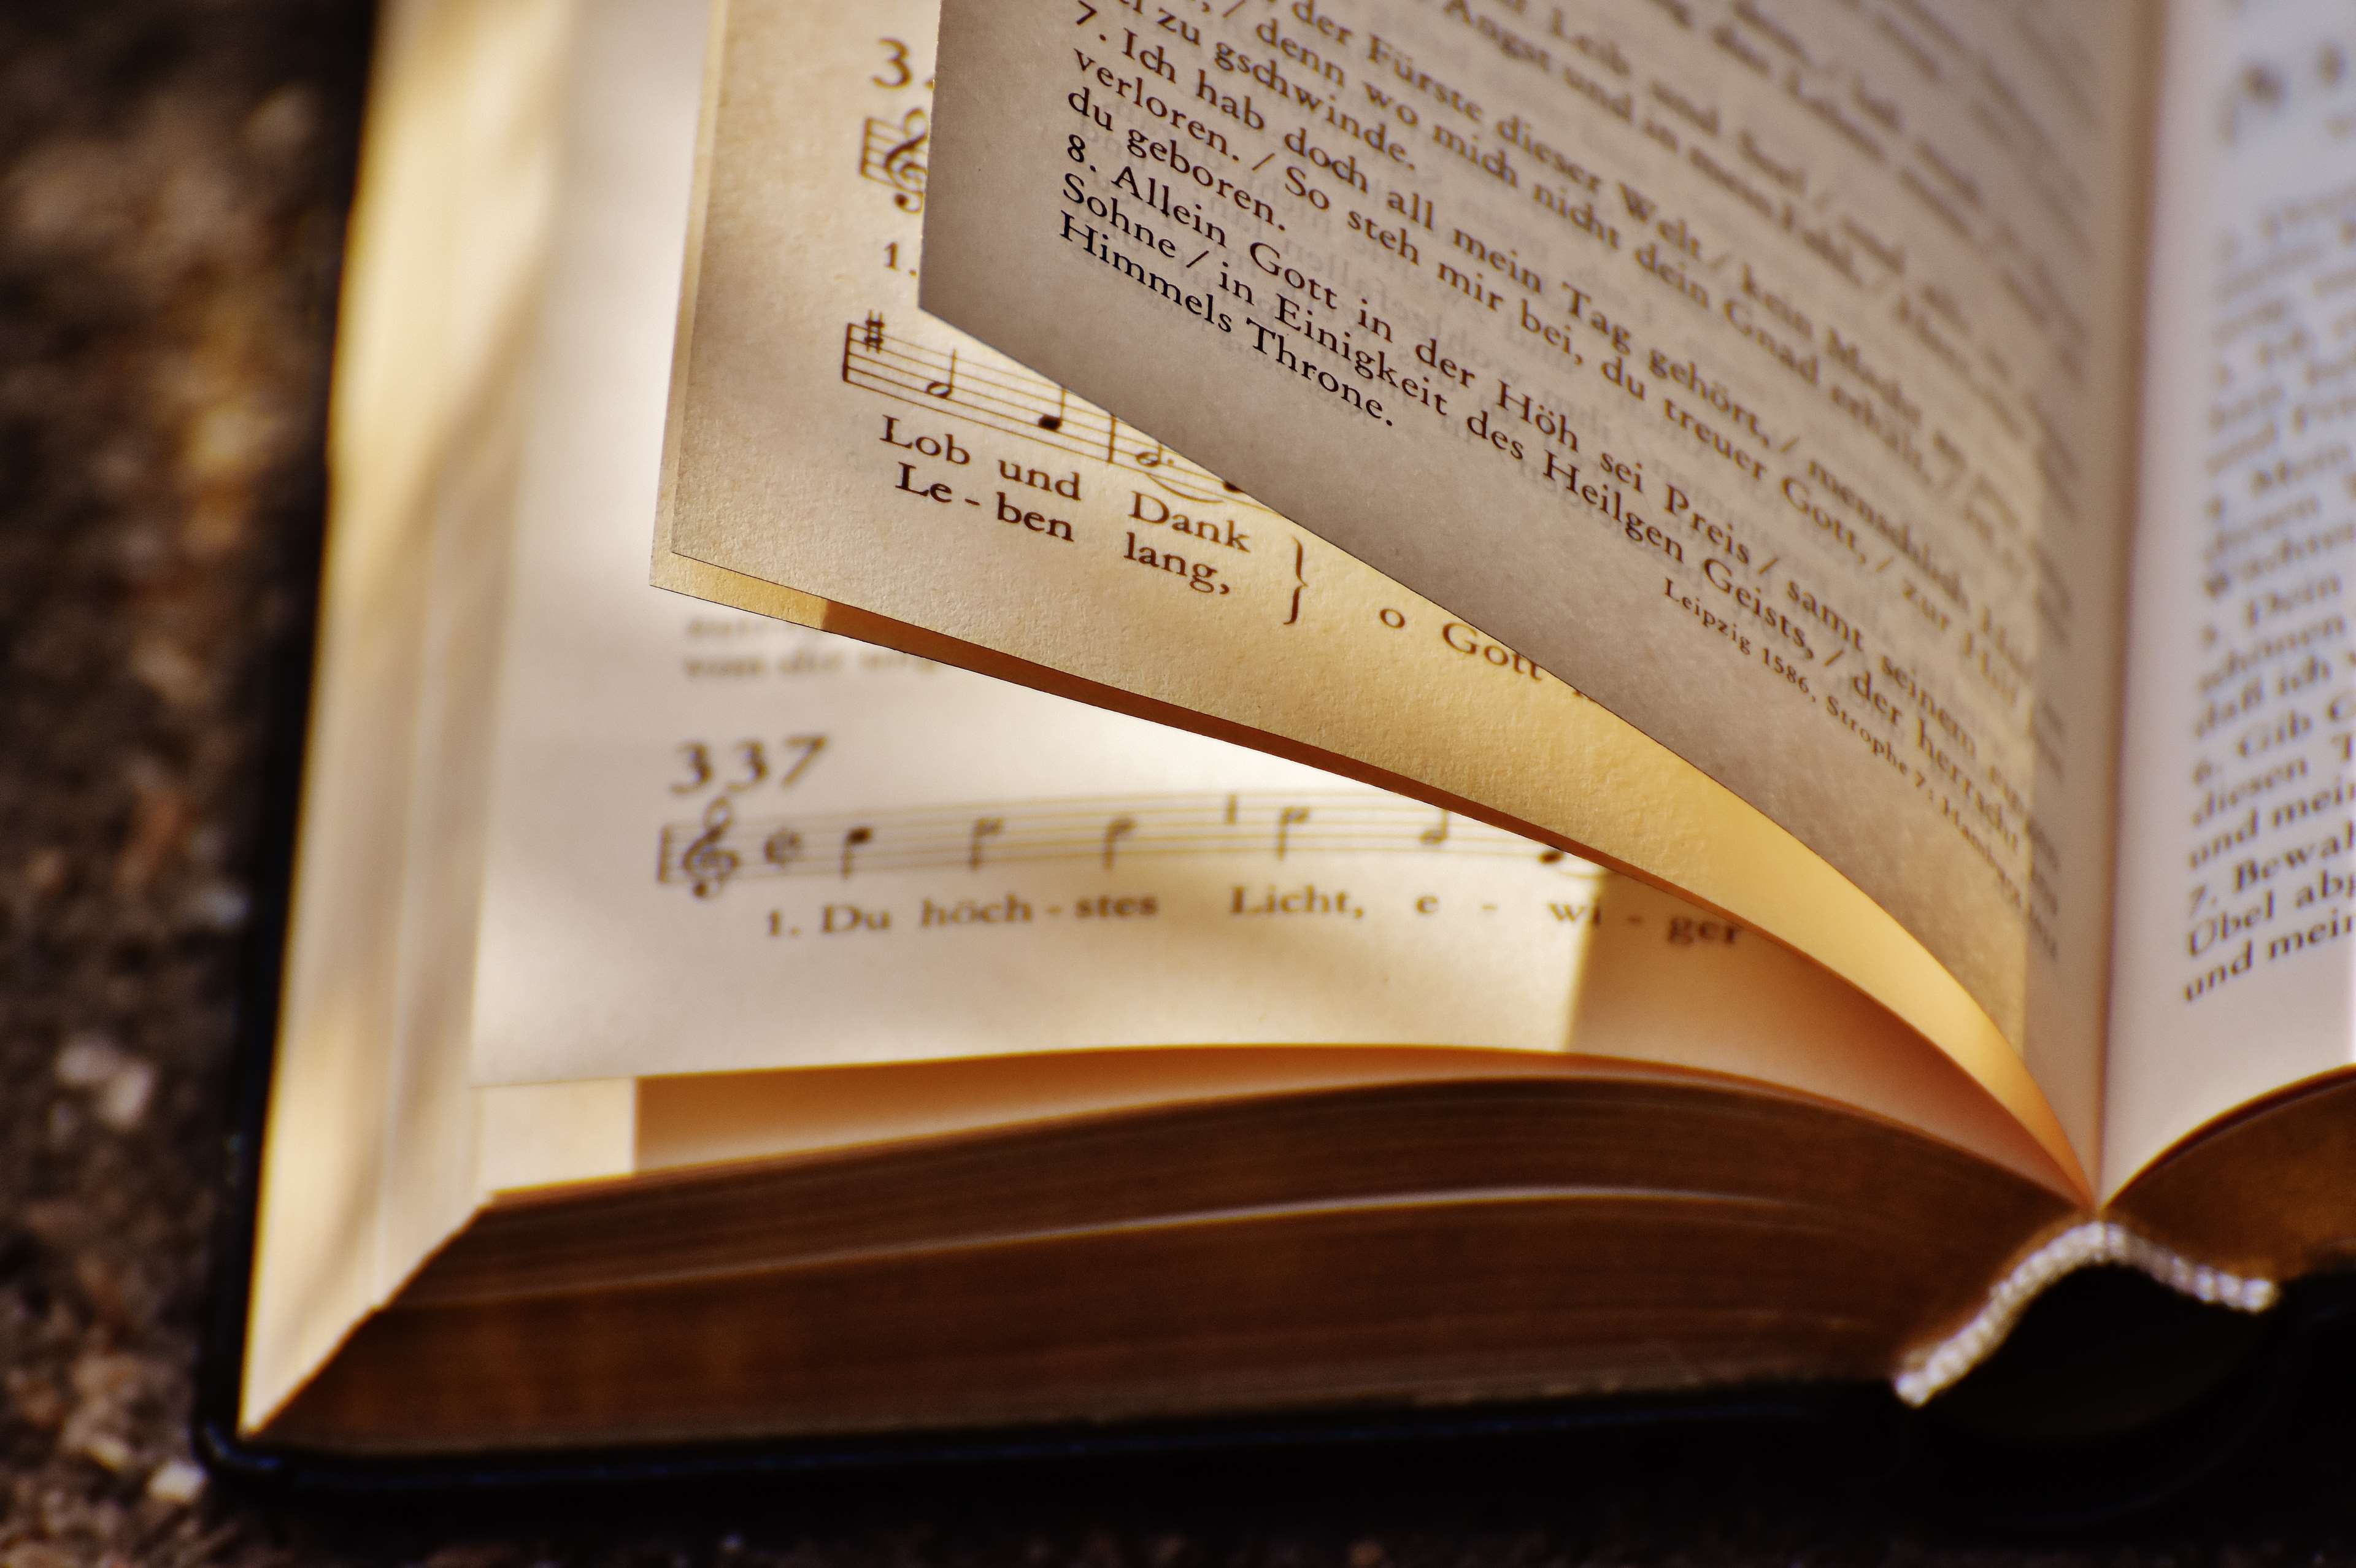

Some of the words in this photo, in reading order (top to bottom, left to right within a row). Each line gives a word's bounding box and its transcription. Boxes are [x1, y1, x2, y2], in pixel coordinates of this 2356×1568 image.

[1068, 86, 1114, 132] du
[1127, 128, 1287, 231] geboren.
[1157, 7, 1201, 46] zu
[1214, 41, 1415, 171] gschwinde.
[1292, 0, 1353, 46] der
[1367, 33, 1485, 122] Fürste
[1496, 115, 1603, 195] dieser
[1619, 183, 1701, 261] Welt
[884, 242, 917, 277] 1.
[1076, 0, 1106, 41] 7.
[1122, 27, 1177, 84] Ich
[1196, 69, 1265, 130] hab
[1285, 127, 1369, 193] doch
[1387, 190, 1434, 231] all
[1453, 228, 1543, 294] mein
[1561, 281, 1631, 356] Tag
[1649, 348, 1770, 448] gehört,
[1256, 18, 1345, 88] denn
[1362, 81, 1420, 126] wo
[1433, 125, 1519, 189] mich
[1533, 184, 1620, 250] nicht
[1634, 243, 1710, 309] dein
[1724, 299, 1819, 388] Gnad
[1060, 209, 1233, 333] Himmels
[1245, 317, 1394, 427] Throne.
[1074, 48, 1240, 162] verloren.
[1285, 164, 1330, 210] So
[1347, 209, 1419, 265] steh
[1438, 261, 1503, 311] mir
[1521, 298, 1584, 366] bei,
[1601, 356, 1646, 401] du
[1664, 398, 1767, 482] treuer
[1781, 476, 1866, 565] Gott,
[1062, 172, 1176, 258] Sohne
[1217, 261, 1255, 306] in
[1274, 293, 1447, 416] Einigkeit
[1467, 410, 1523, 461] des
[1543, 449, 1684, 563] Heilgen
[1703, 558, 1814, 660] Geists,
[1852, 671, 1903, 726] der
[1067, 133, 1098, 172] 8.
[1111, 166, 1226, 247] Allein
[1249, 242, 1338, 310] Gott
[1358, 299, 1393, 344] in
[1415, 337, 1476, 389] der
[1496, 379, 1579, 453] Höh
[1600, 451, 1644, 493] sei
[1664, 483, 1750, 566] Preis
[1787, 579, 1863, 651] samt
[880, 414, 971, 466] Lob
[998, 459, 1082, 502] und
[1128, 491, 1251, 553] Dank
[996, 491, 1074, 543] ben
[1124, 532, 1230, 596] lang,
[1379, 608, 1405, 629] o
[1664, 577, 1750, 655] Leipzig
[1825, 695, 1908, 776] Strophe
[670, 733, 827, 794] 337
[2189, 806, 2260, 870] und
[766, 909, 801, 938] 1.
[821, 904, 891, 934] Du
[1075, 891, 1160, 921] stes
[1230, 884, 1364, 920] Licht,
[1415, 891, 1439, 915] e
[1548, 896, 1602, 925] wi
[1666, 913, 1741, 948] ger
[2182, 939, 2252, 1003] und
